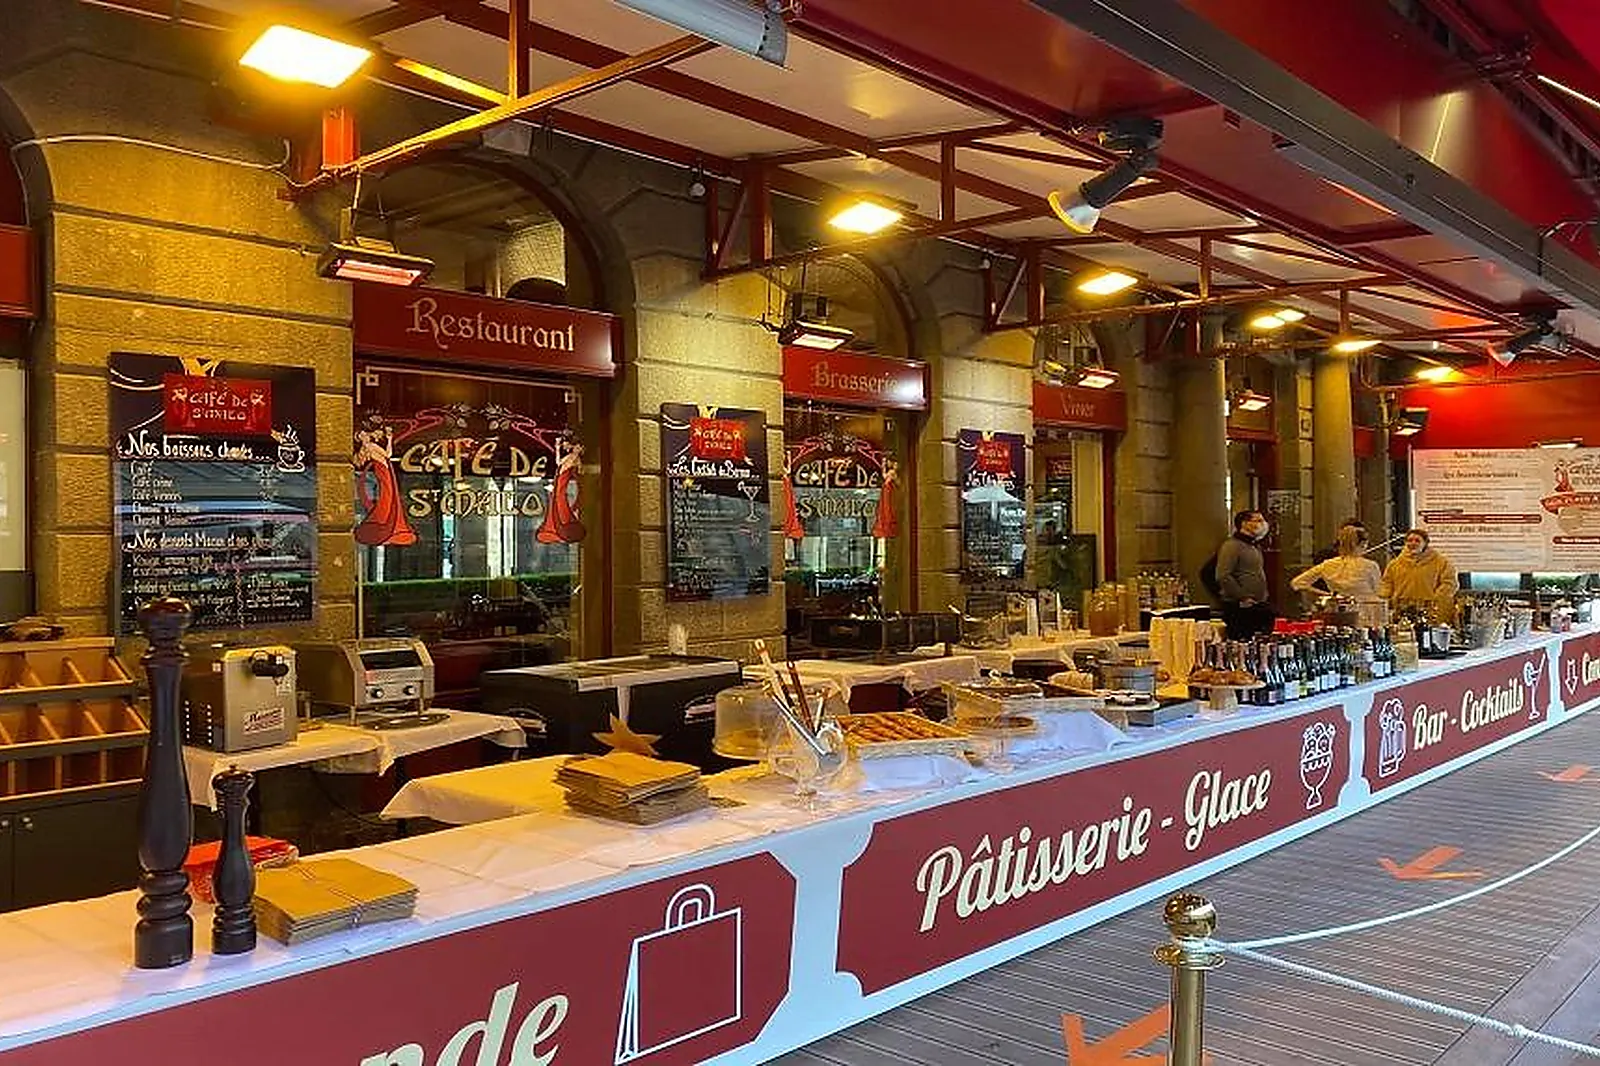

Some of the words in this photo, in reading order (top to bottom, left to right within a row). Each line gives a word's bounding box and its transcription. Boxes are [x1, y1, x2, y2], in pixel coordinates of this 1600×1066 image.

[405, 297, 574, 351] Restaurant
[811, 361, 899, 393] Brasserie
[1413, 704, 1448, 750] Bar
[1461, 678, 1524, 733] Cocktails
[916, 797, 1151, 932] Pâtisserie
[1185, 769, 1272, 851] Glace
